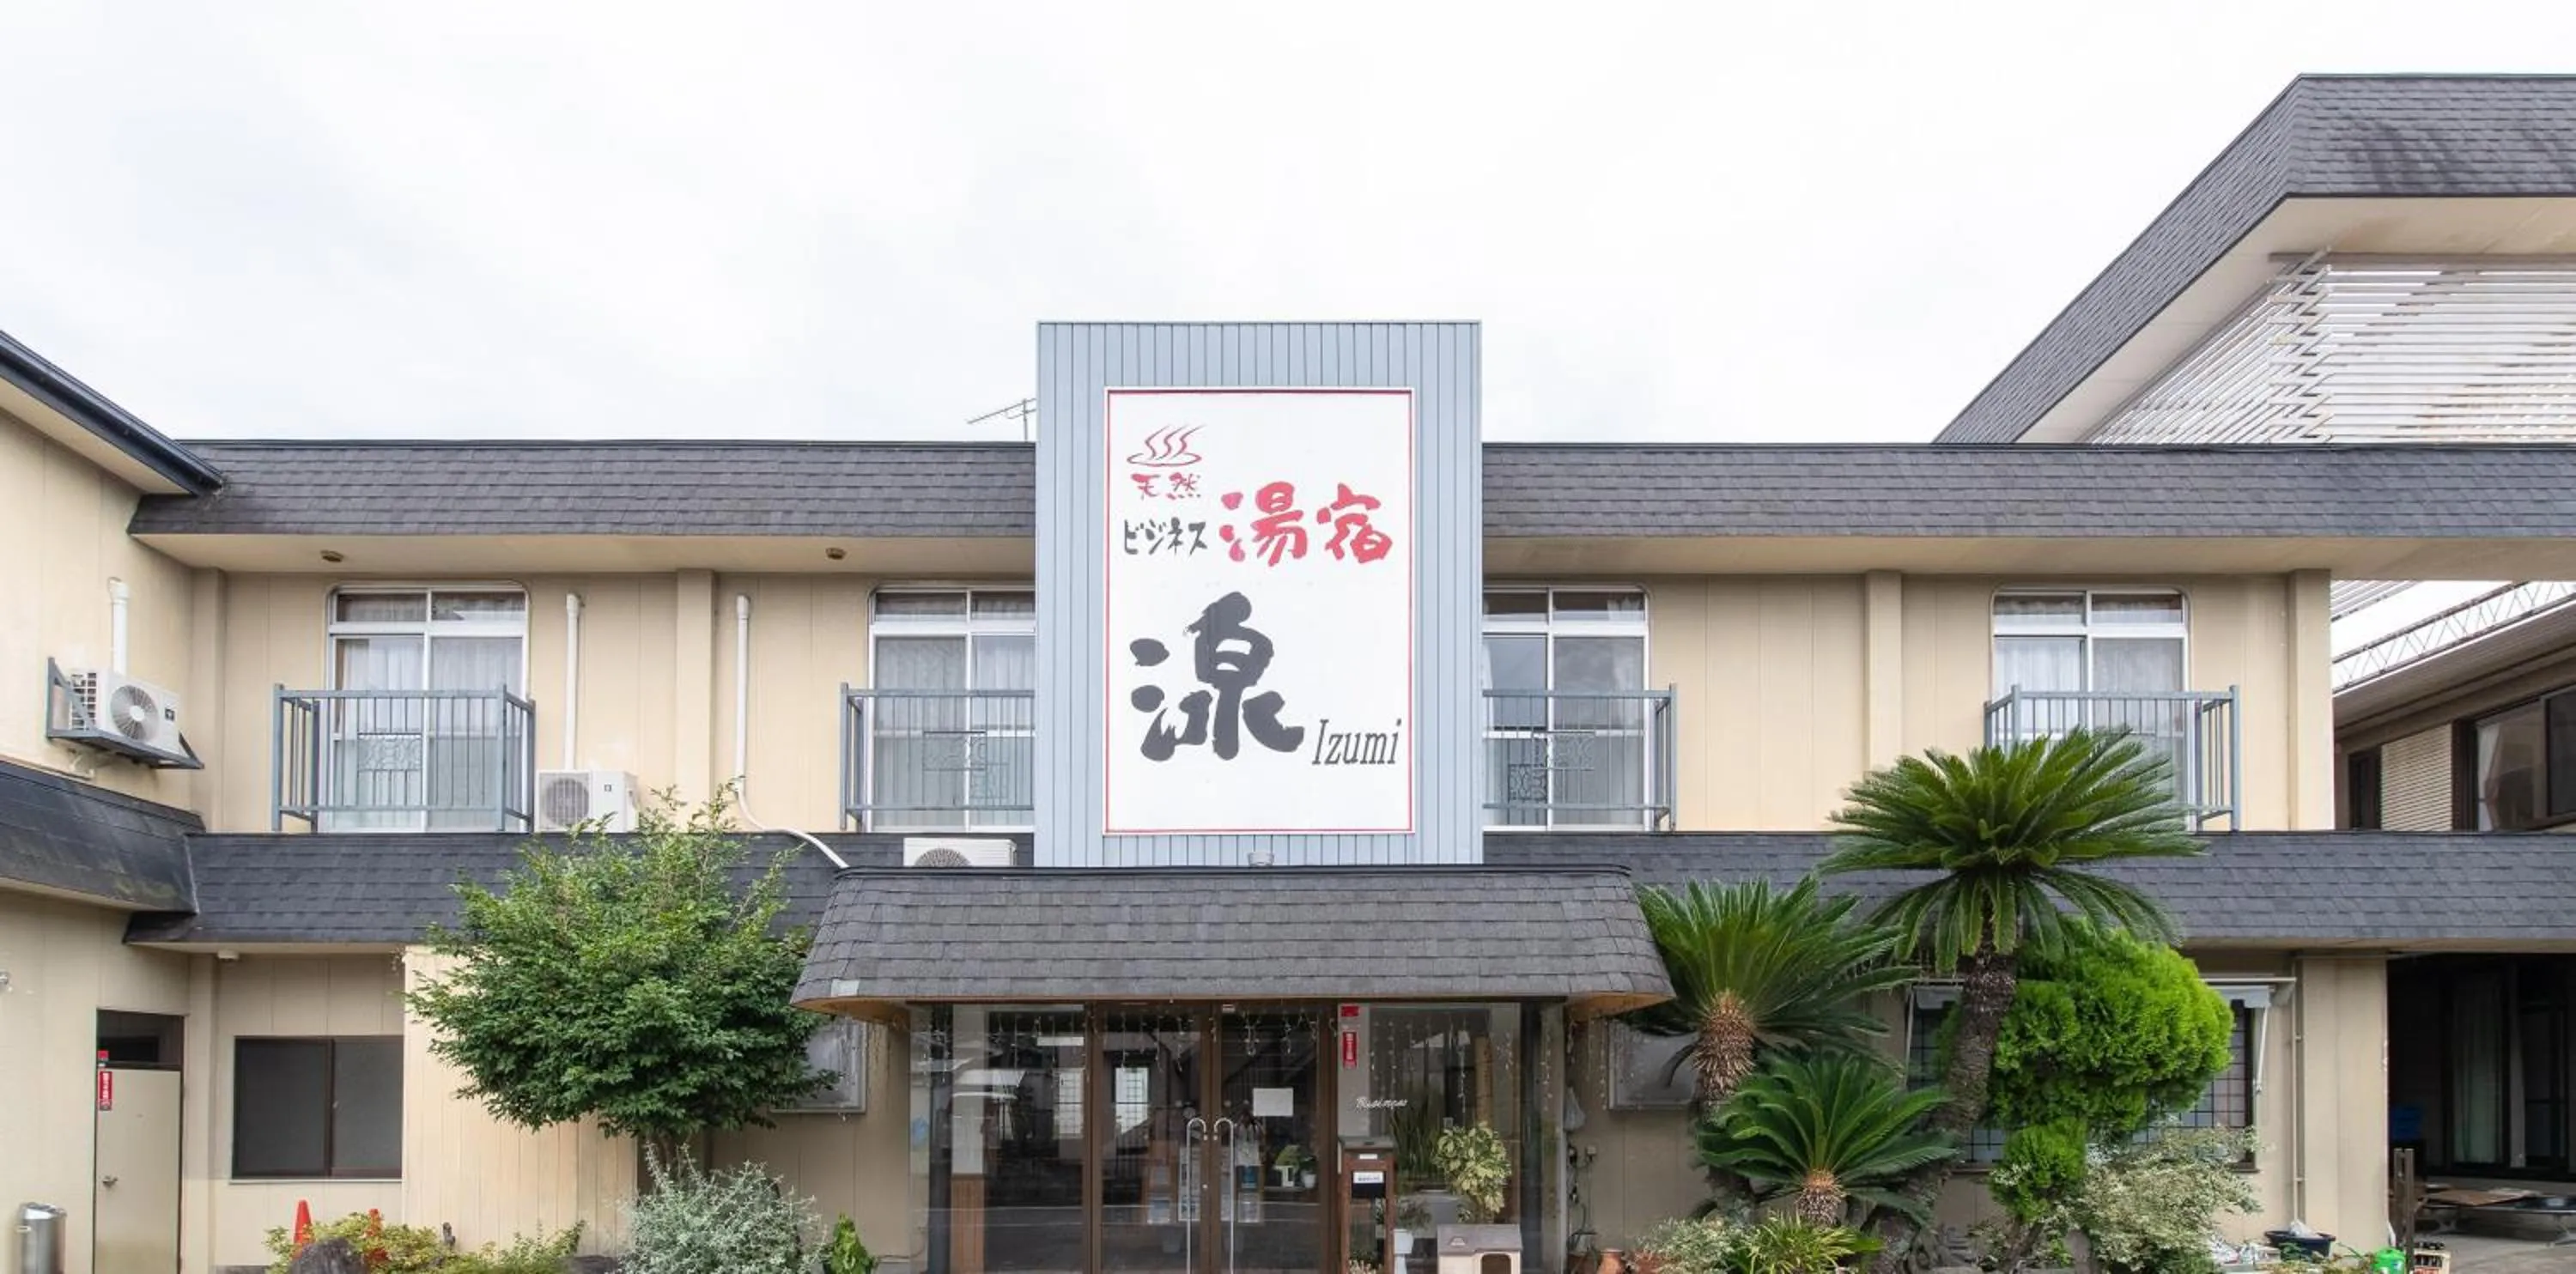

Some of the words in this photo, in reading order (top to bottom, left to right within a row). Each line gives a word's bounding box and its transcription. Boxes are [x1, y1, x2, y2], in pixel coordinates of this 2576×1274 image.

[1130, 471, 1201, 500] 天然
[1124, 516, 1208, 558] ビジネス
[1218, 481, 1393, 567] 湯宿
[1312, 719, 1401, 766] Izumi
